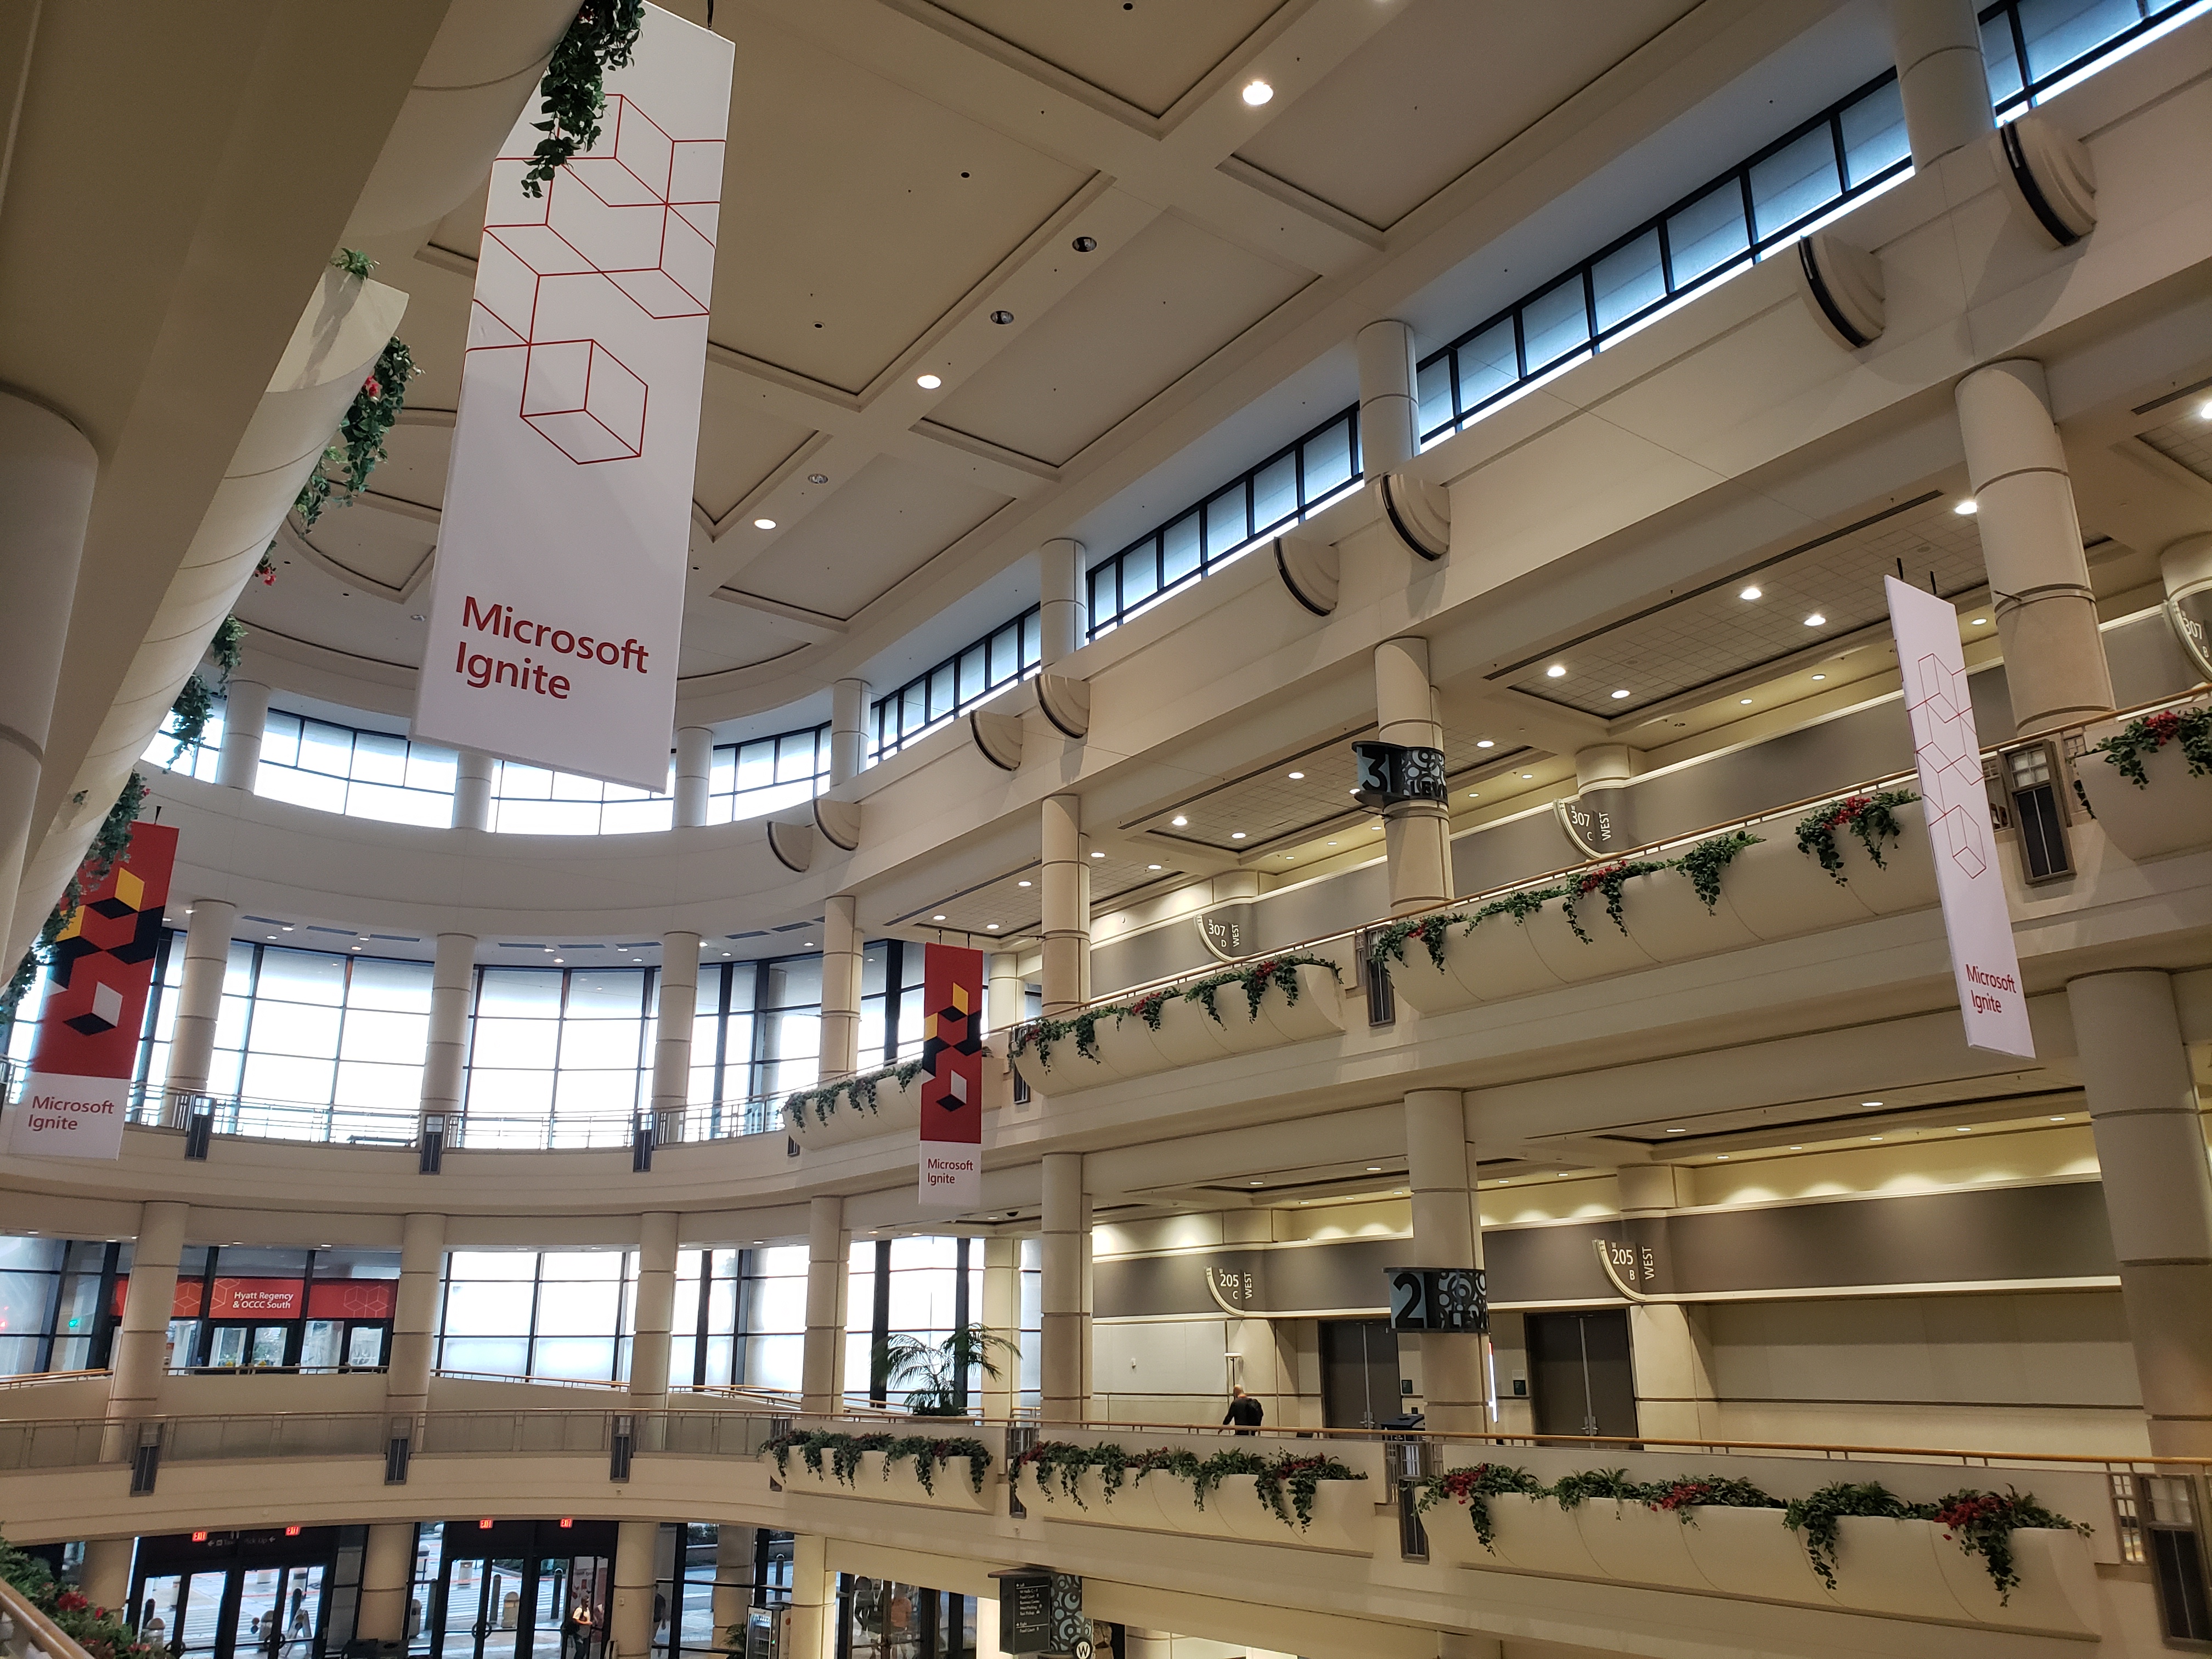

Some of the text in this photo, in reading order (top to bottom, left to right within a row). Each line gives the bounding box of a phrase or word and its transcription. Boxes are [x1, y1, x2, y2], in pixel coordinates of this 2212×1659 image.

[462, 595, 649, 674] Microsoft
[2183, 617, 2202, 640] 307
[455, 641, 571, 699] Ignite
[1362, 746, 1388, 792] 3
[1410, 781, 1447, 798] LEV
[1571, 811, 1590, 827] 307
[1599, 812, 1611, 841] WEST
[1587, 831, 1593, 841] C
[1208, 923, 1226, 936] 307
[1231, 924, 1240, 947] WEST
[1221, 939, 1227, 947] D
[1966, 964, 2017, 994] Microsoft
[1971, 989, 2002, 1014] Ignite
[32, 1096, 114, 1114] Microsoft
[28, 1114, 78, 1131] Ignite
[928, 1158, 973, 1171] Microsoft
[928, 1172, 955, 1186] Ignite
[1612, 1249, 1633, 1265] 205
[1641, 1246, 1655, 1280] WEST
[1220, 1274, 1239, 1288] 205
[1629, 1269, 1635, 1280] B
[1244, 1272, 1252, 1299] WEST
[234, 1291, 294, 1301] Hyatt Regency
[1232, 1290, 1238, 1300] C
[1393, 1273, 1424, 1328] 2
[1078, 1645, 1088, 1658] W
